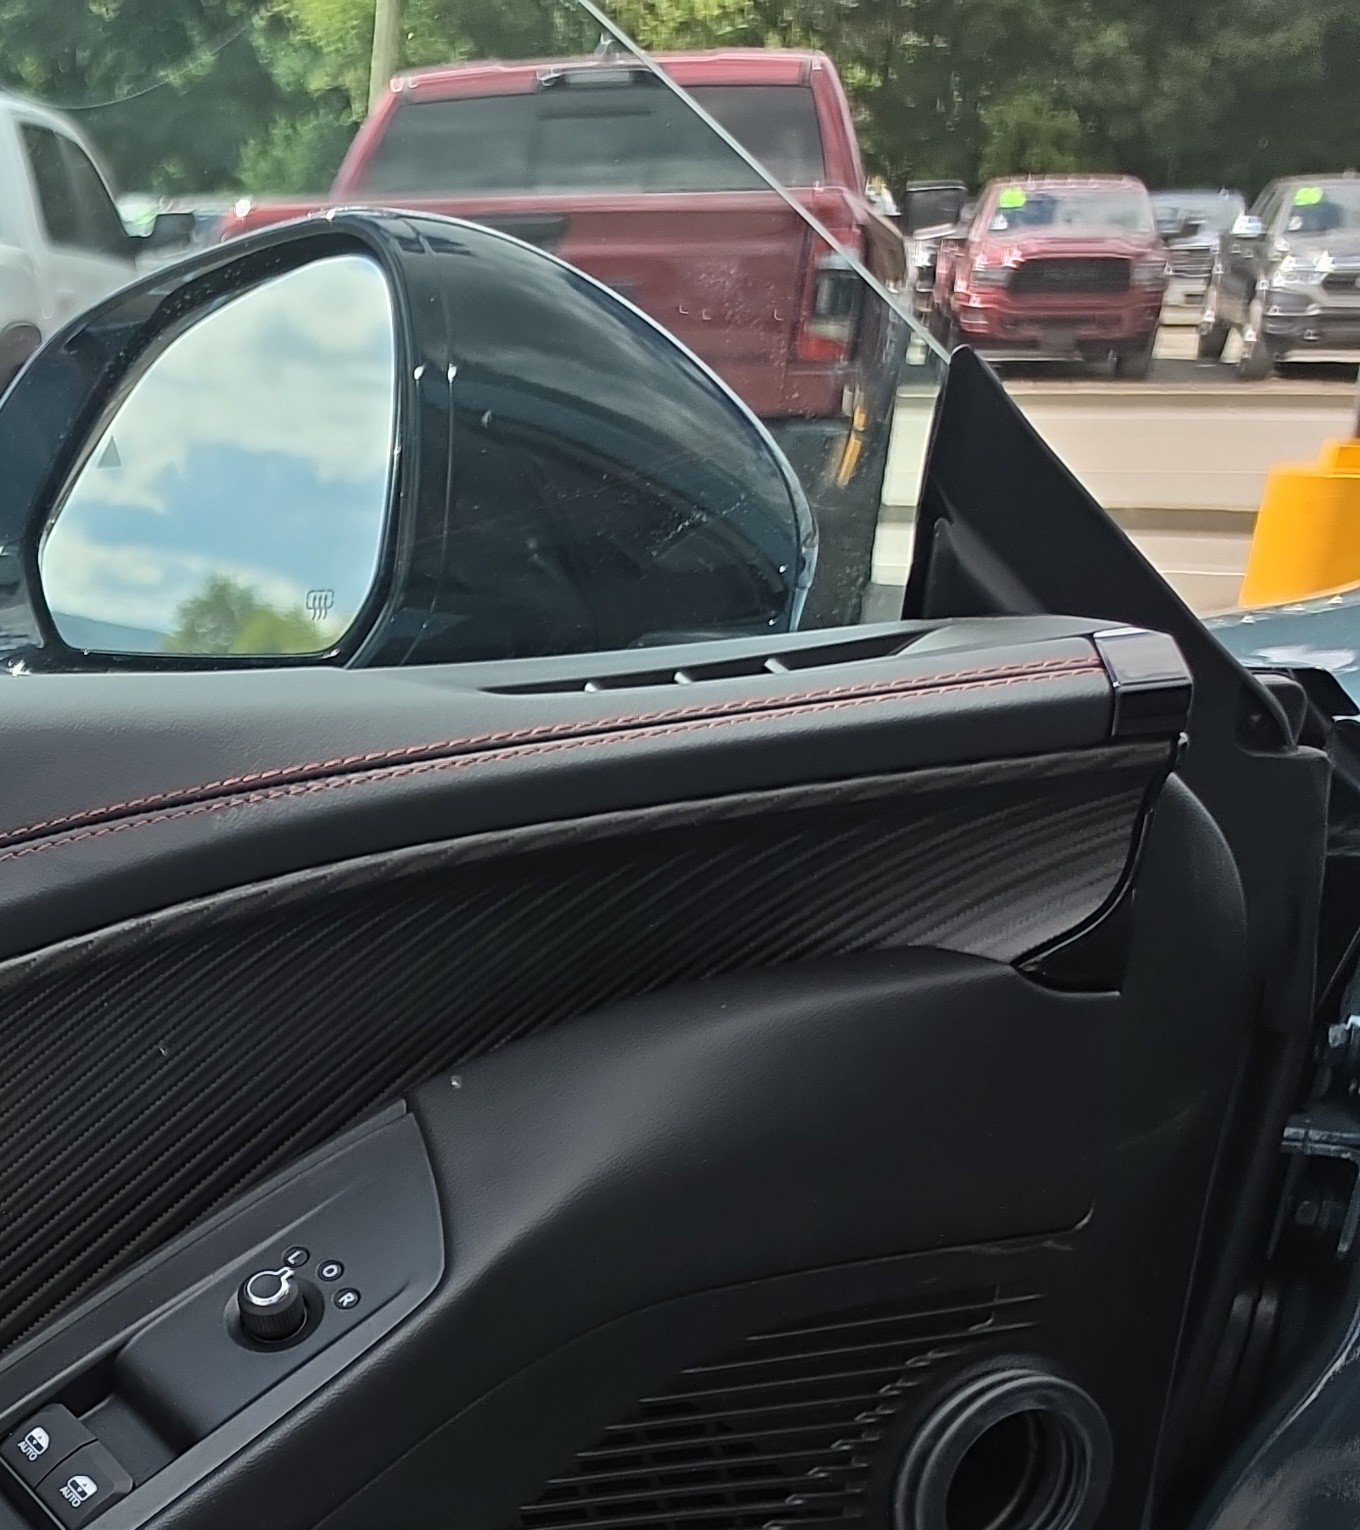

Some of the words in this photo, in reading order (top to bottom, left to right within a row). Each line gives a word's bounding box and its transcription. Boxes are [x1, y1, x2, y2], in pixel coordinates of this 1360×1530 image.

[287, 1250, 301, 1264] L
[338, 1292, 355, 1307] R
[17, 1439, 39, 1462] AUTO
[59, 1485, 82, 1508] AUTO
